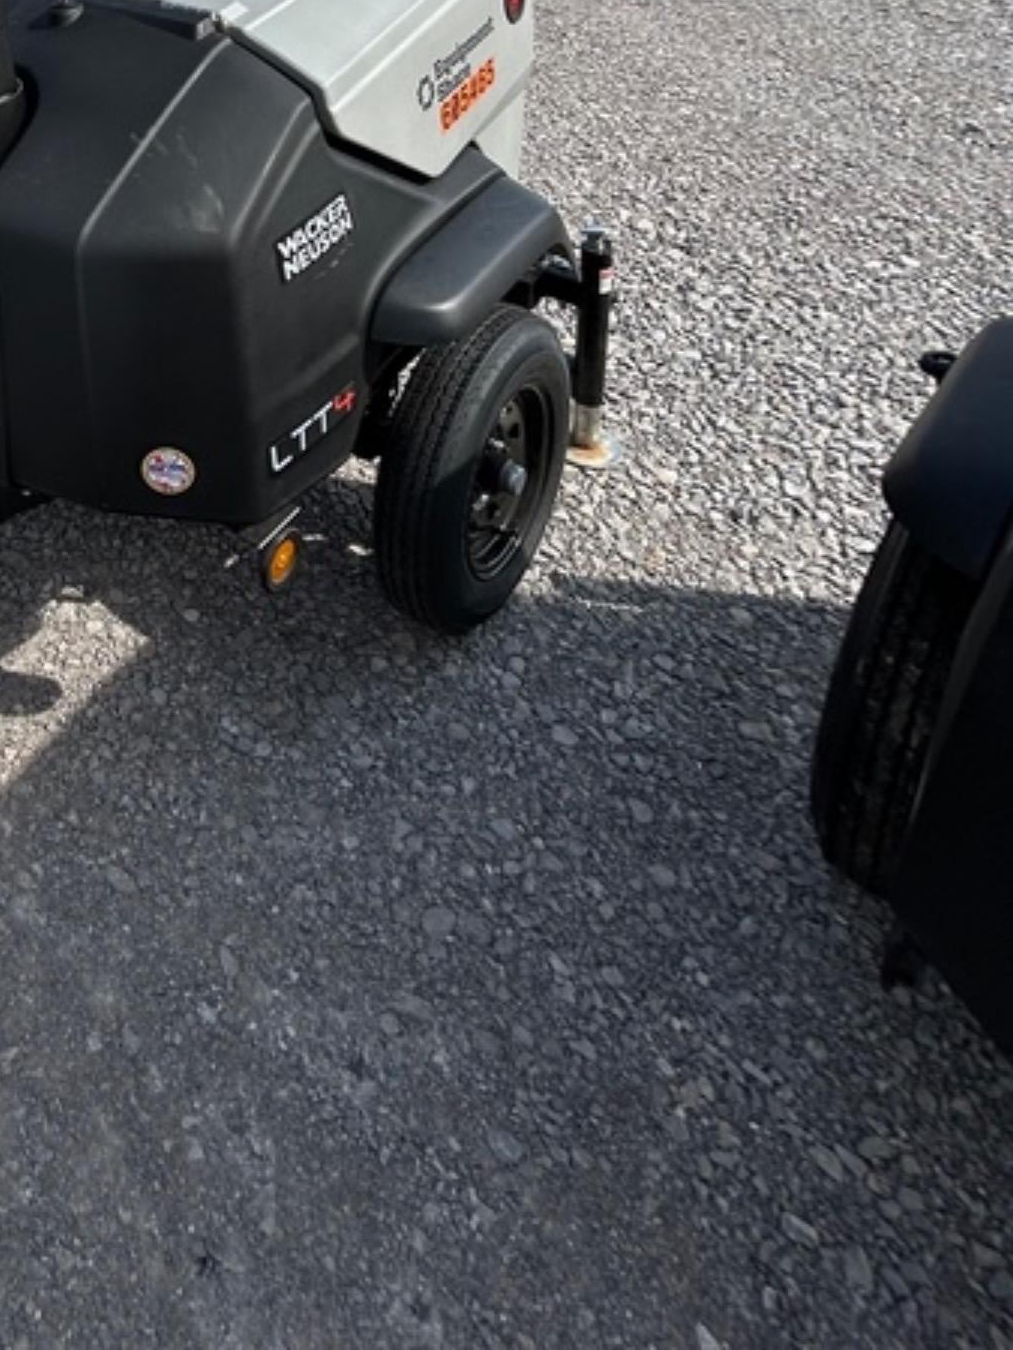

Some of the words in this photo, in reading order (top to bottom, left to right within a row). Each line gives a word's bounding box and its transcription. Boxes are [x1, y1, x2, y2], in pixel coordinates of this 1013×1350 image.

[277, 194, 348, 259] WACKER
[283, 212, 353, 281] NEUSON
[270, 387, 357, 472] LTT4
